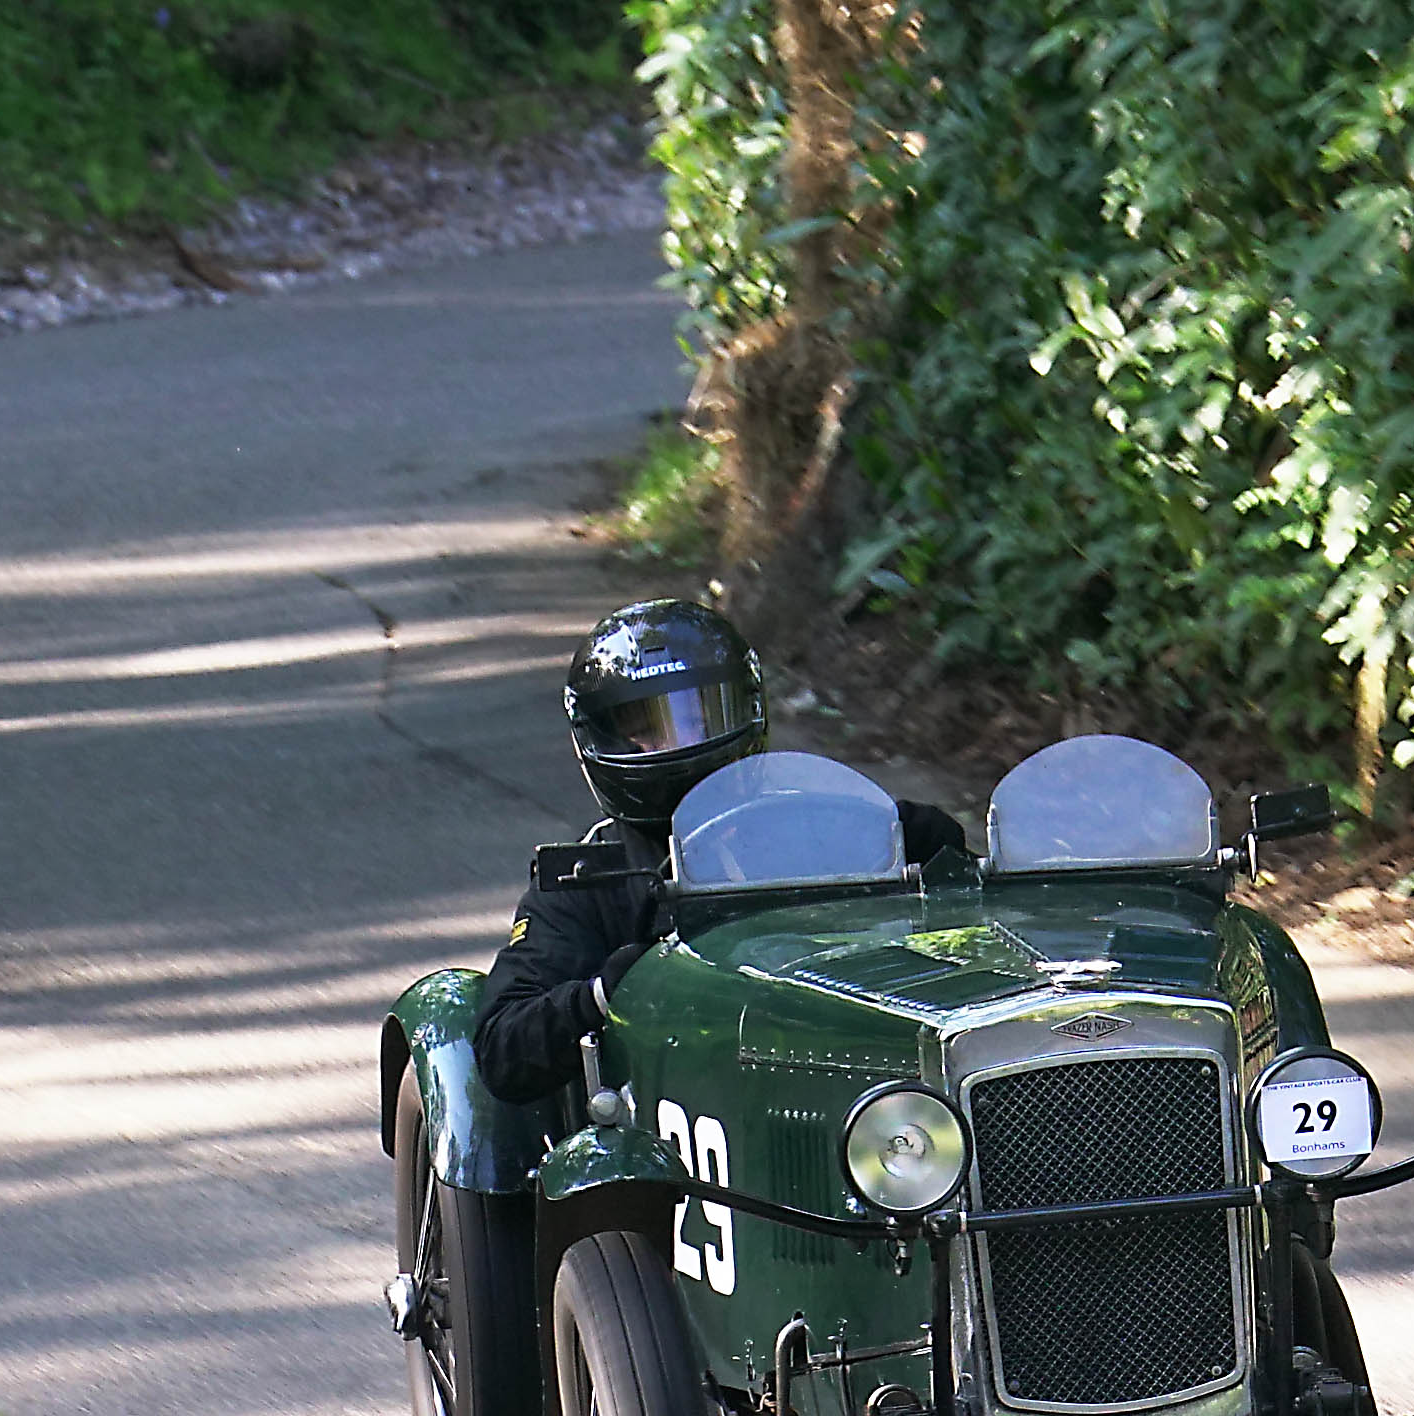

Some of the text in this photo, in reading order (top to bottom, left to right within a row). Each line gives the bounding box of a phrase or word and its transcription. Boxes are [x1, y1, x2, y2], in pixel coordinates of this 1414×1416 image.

[1292, 1099, 1337, 1134] 29
[1292, 1141, 1346, 1154] Bonhams
[657, 1098, 736, 1297] 29
